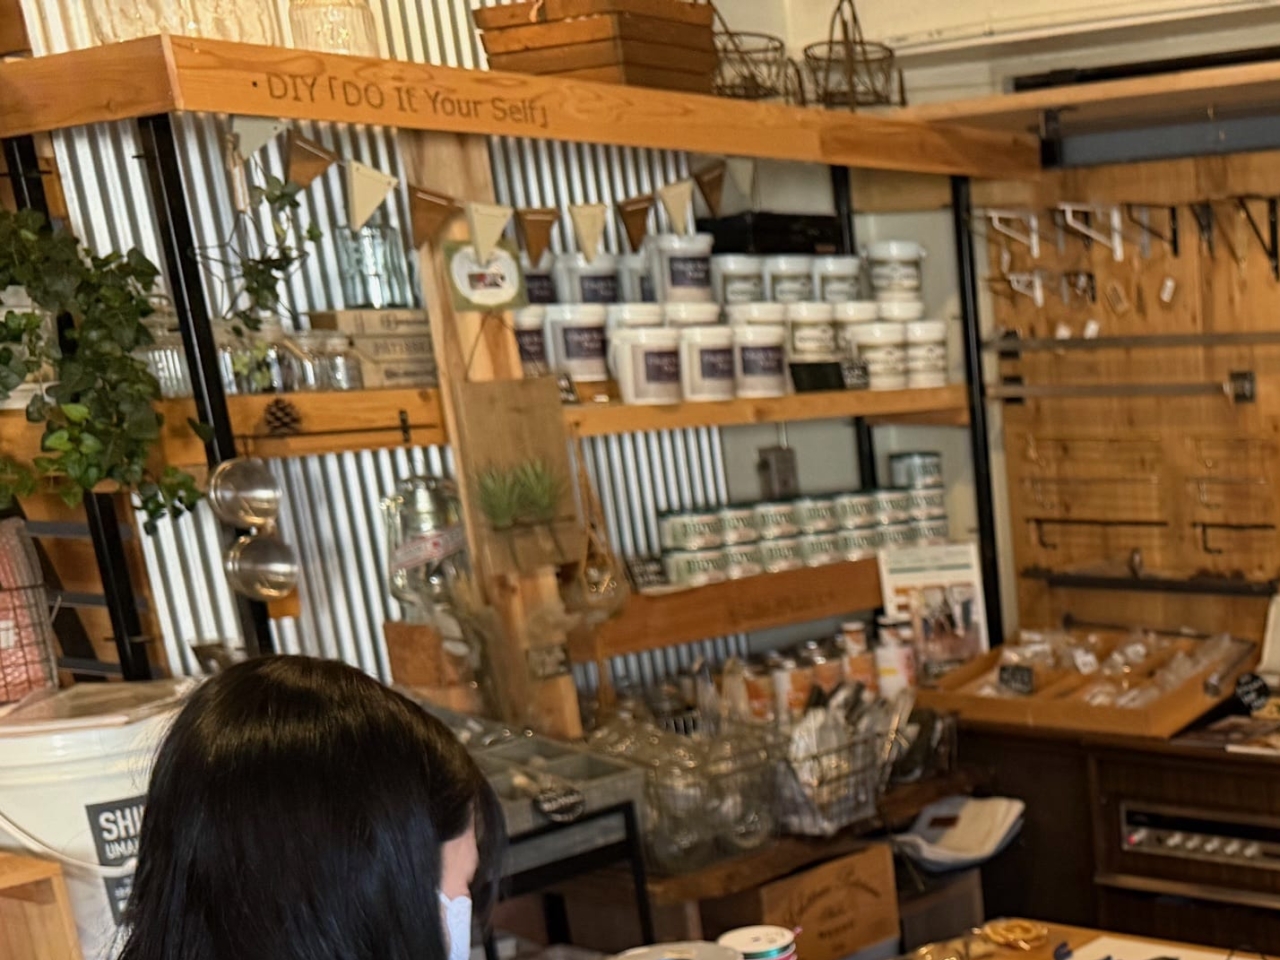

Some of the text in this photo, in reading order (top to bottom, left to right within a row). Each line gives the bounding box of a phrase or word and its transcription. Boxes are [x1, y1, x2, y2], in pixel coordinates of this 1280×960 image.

[266, 73, 318, 103] DIY
[397, 86, 418, 113] It
[424, 88, 484, 118] Your
[99, 805, 145, 840] SHI
